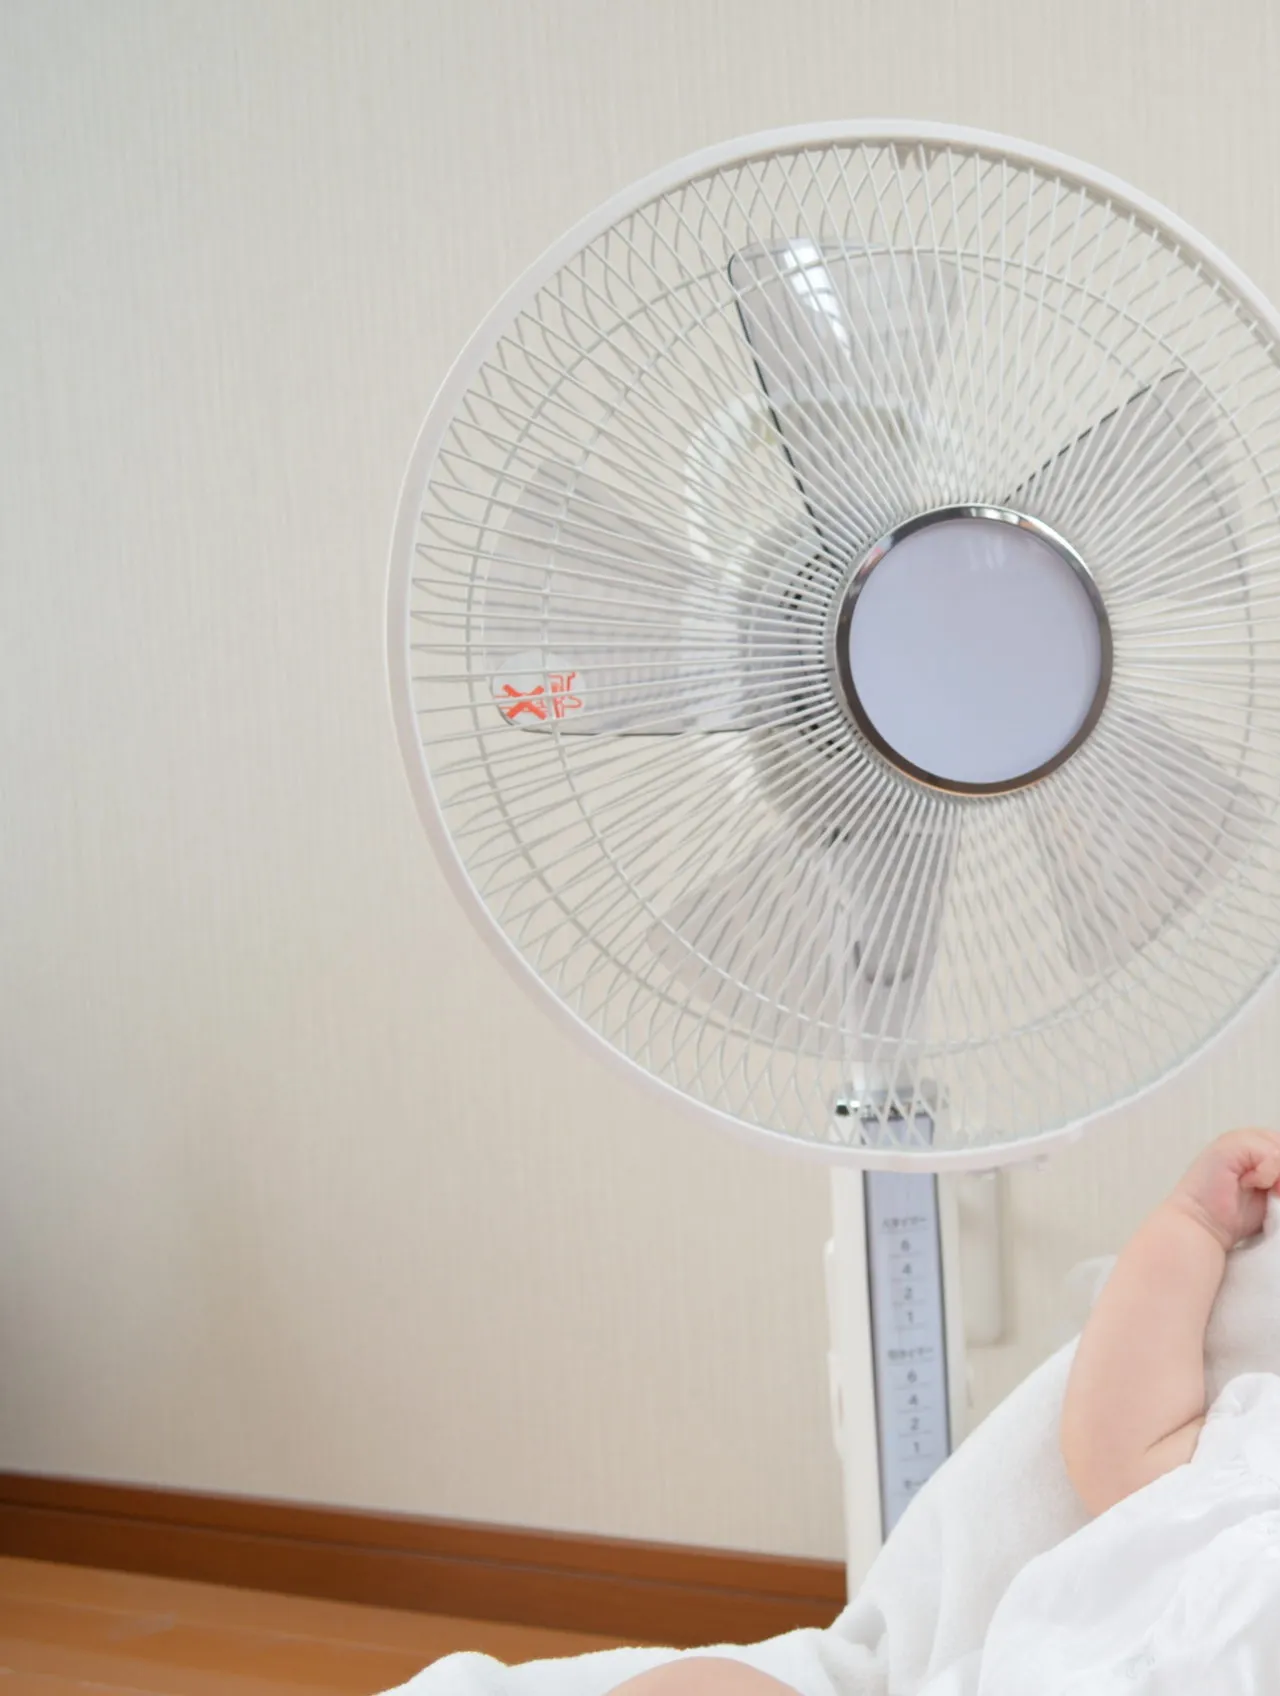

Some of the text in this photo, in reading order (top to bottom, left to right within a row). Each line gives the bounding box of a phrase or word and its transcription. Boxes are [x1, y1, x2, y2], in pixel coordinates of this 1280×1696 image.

[902, 1263, 912, 1275] 4
[904, 1286, 912, 1300] 2
[907, 1369, 917, 1383] 6
[908, 1394, 918, 1406] 4
[910, 1416, 919, 1430] 2
